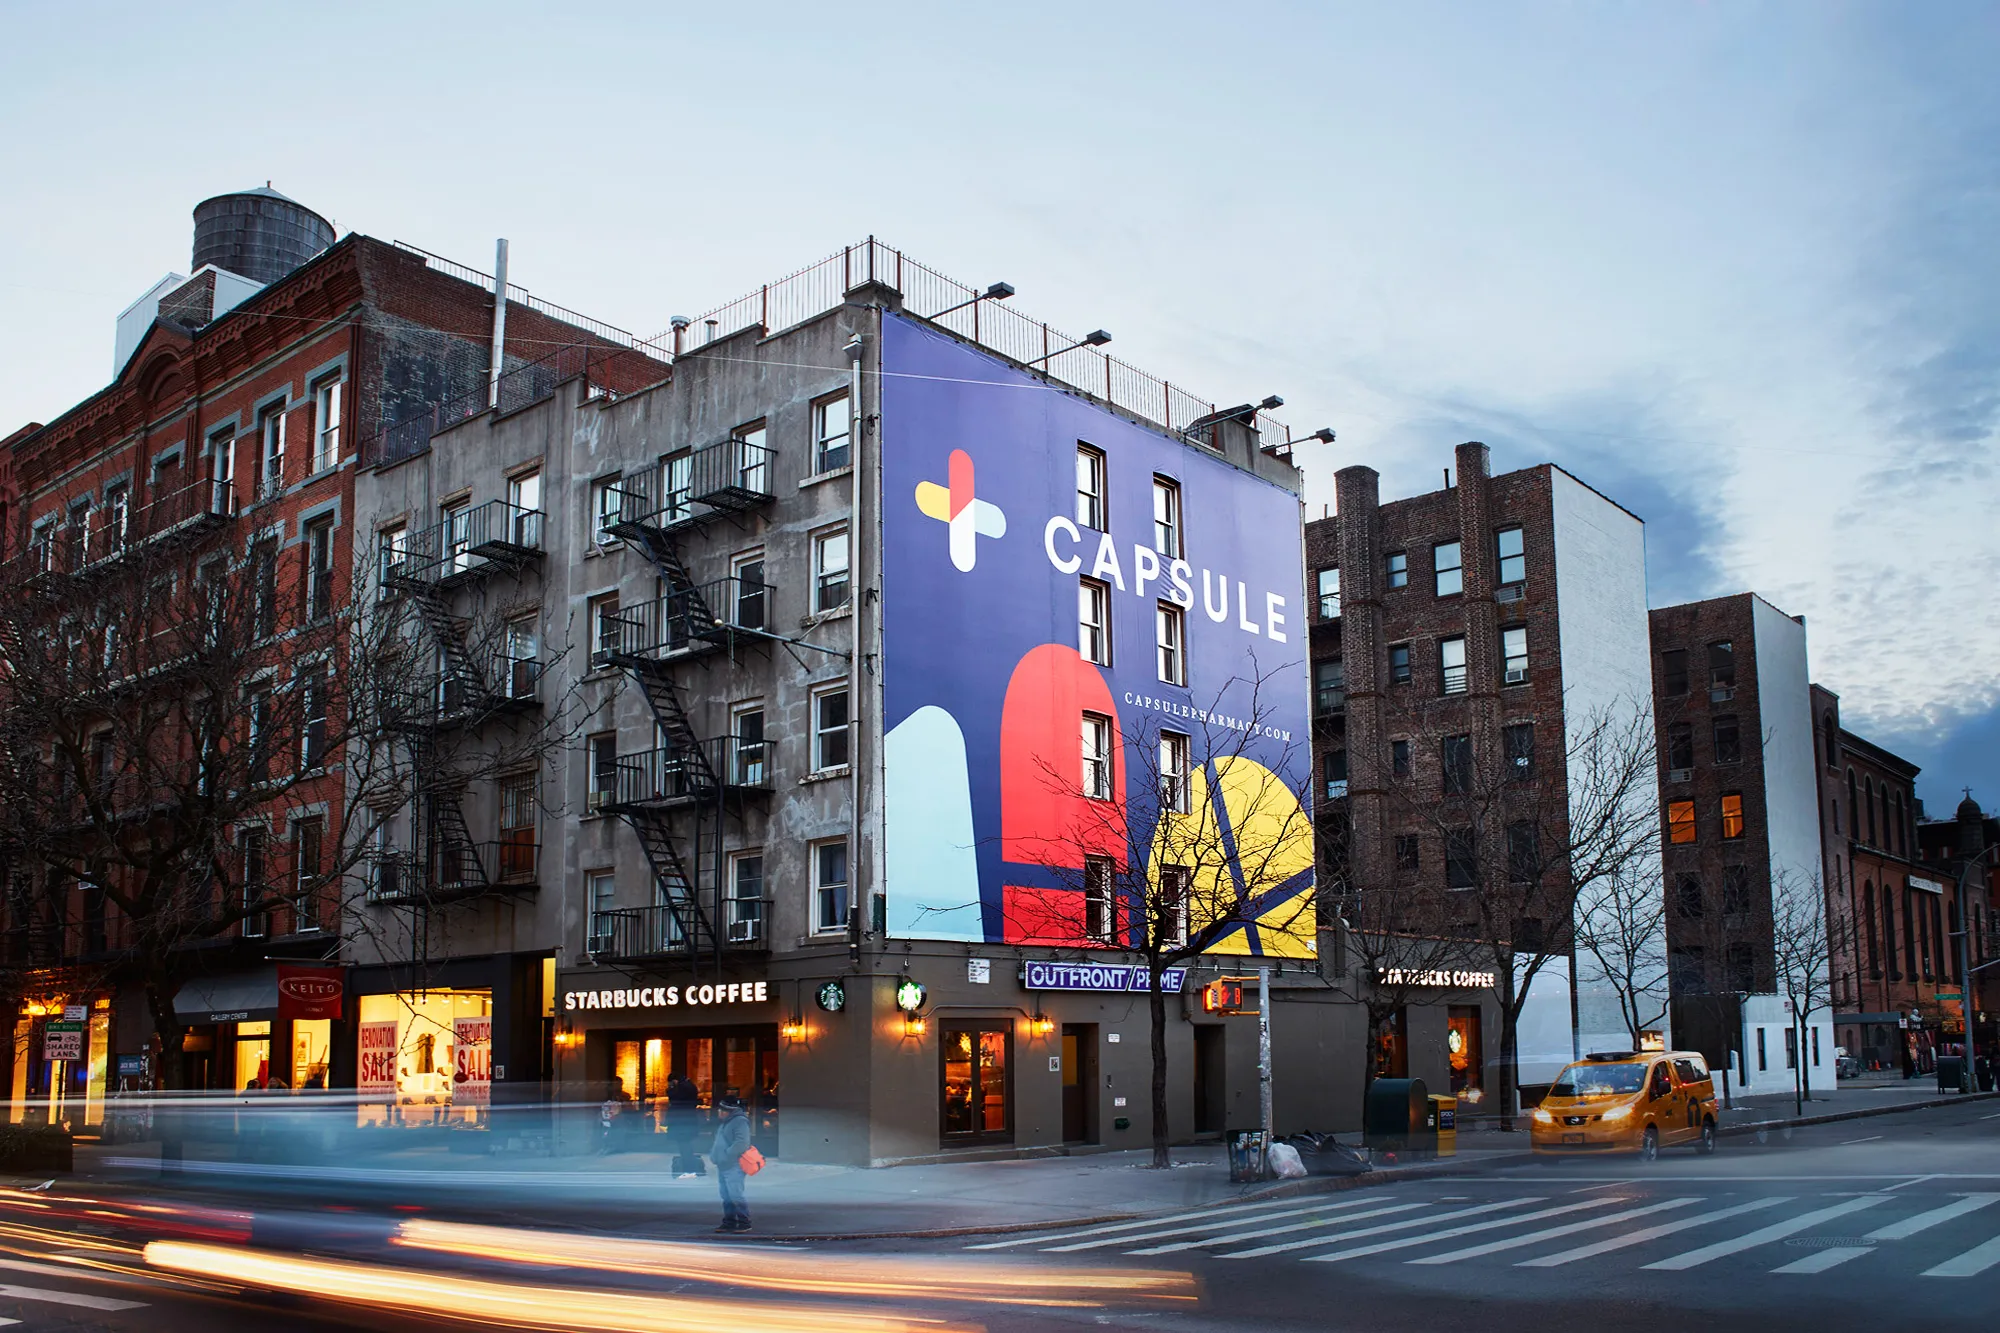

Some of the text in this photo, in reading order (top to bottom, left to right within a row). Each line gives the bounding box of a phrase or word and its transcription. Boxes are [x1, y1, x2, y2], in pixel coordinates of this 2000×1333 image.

[1044, 515, 1287, 644] CAPSULE
[1125, 692, 1292, 742] CAPSULEPHARMACY.COM
[289, 983, 335, 994] KEITO
[1031, 966, 1180, 989] OUTFRONT PME
[1453, 971, 1494, 988] COFFEE
[565, 982, 767, 1010] STARBUCKS COFFEE
[361, 1026, 395, 1049] RENOVATION
[51, 1050, 73, 1058] LANE
[362, 1051, 394, 1082] SALE
[457, 1049, 491, 1081] SALE
